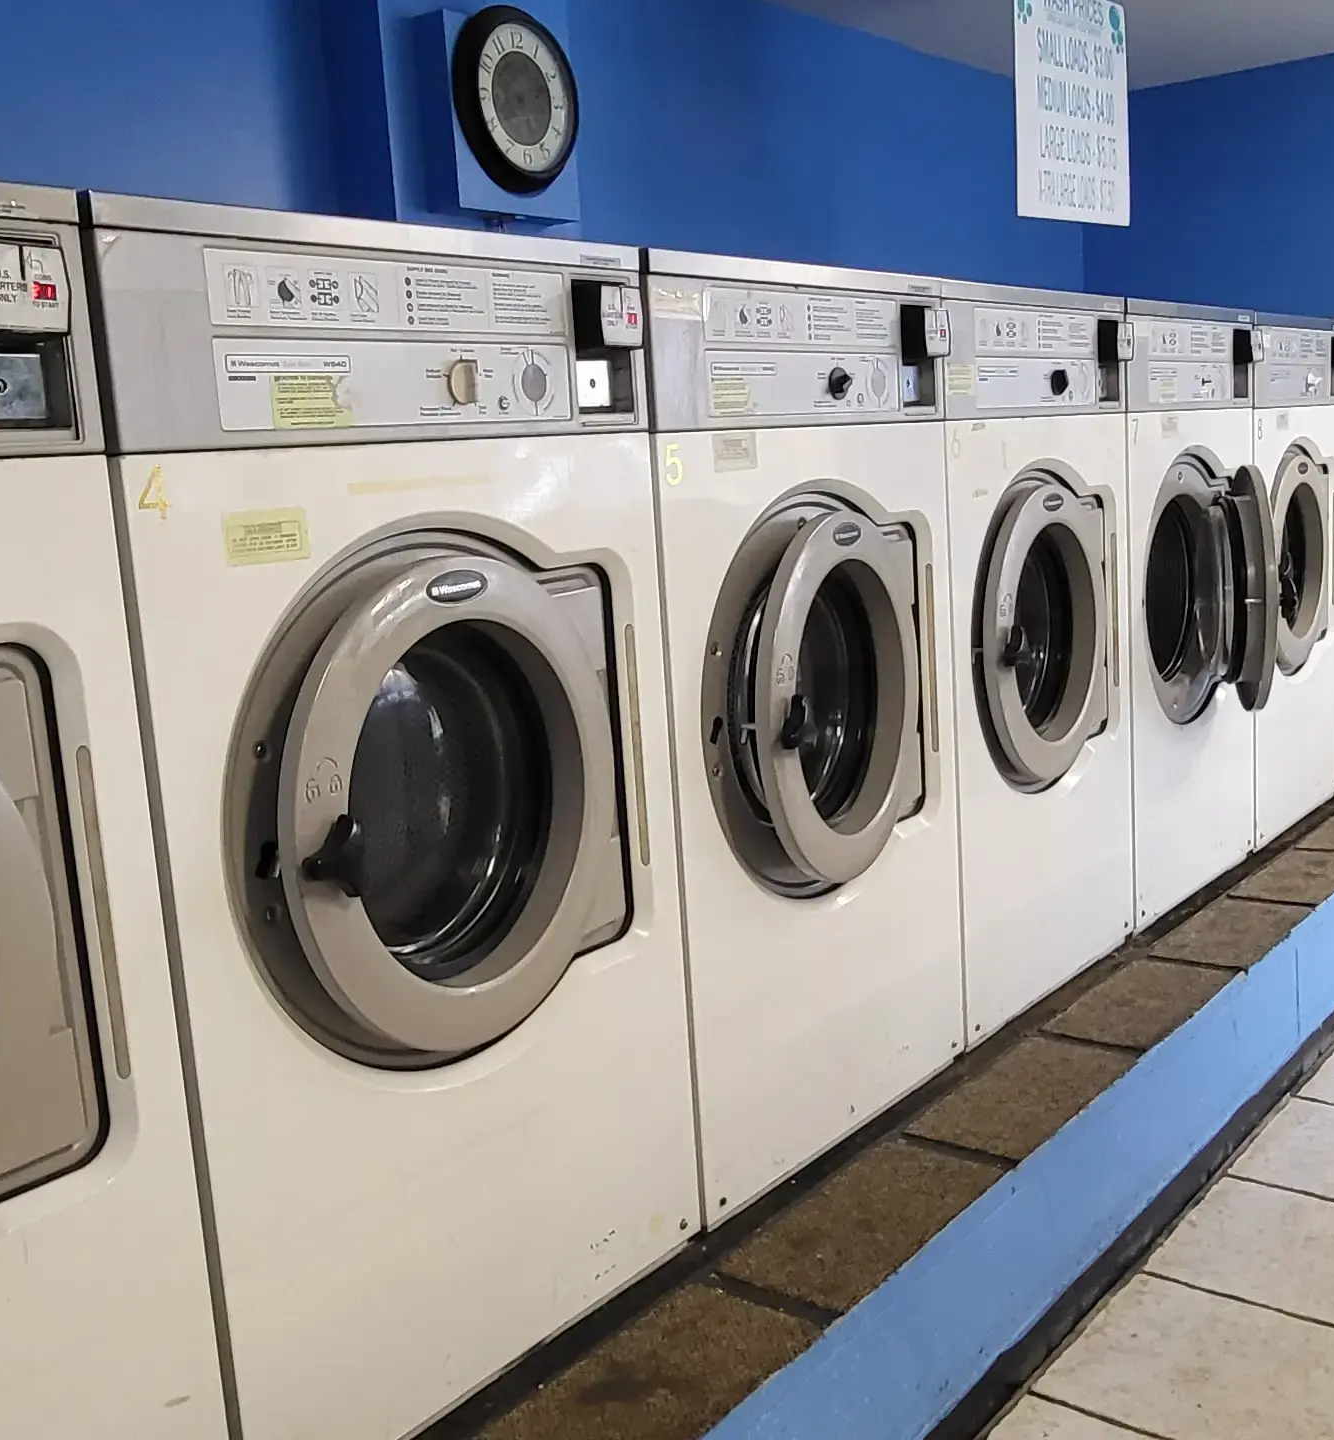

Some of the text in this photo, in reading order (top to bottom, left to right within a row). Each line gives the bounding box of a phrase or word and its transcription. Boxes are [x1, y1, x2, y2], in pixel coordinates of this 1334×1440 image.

[492, 36, 506, 55] 11
[509, 31, 524, 49] 12
[1037, 27, 1063, 67] SMALL
[1064, 36, 1088, 74] LOADS
[480, 53, 494, 74] 10
[1037, 74, 1066, 113] MEDIUM
[1068, 81, 1091, 120] LOADS
[1040, 122, 1065, 160] LARGE
[1067, 127, 1091, 165] LOADS
[1131, 418, 1139, 445] 7
[1257, 418, 1263, 440] 8
[665, 443, 683, 486] 5
[139, 464, 170, 520] 4
